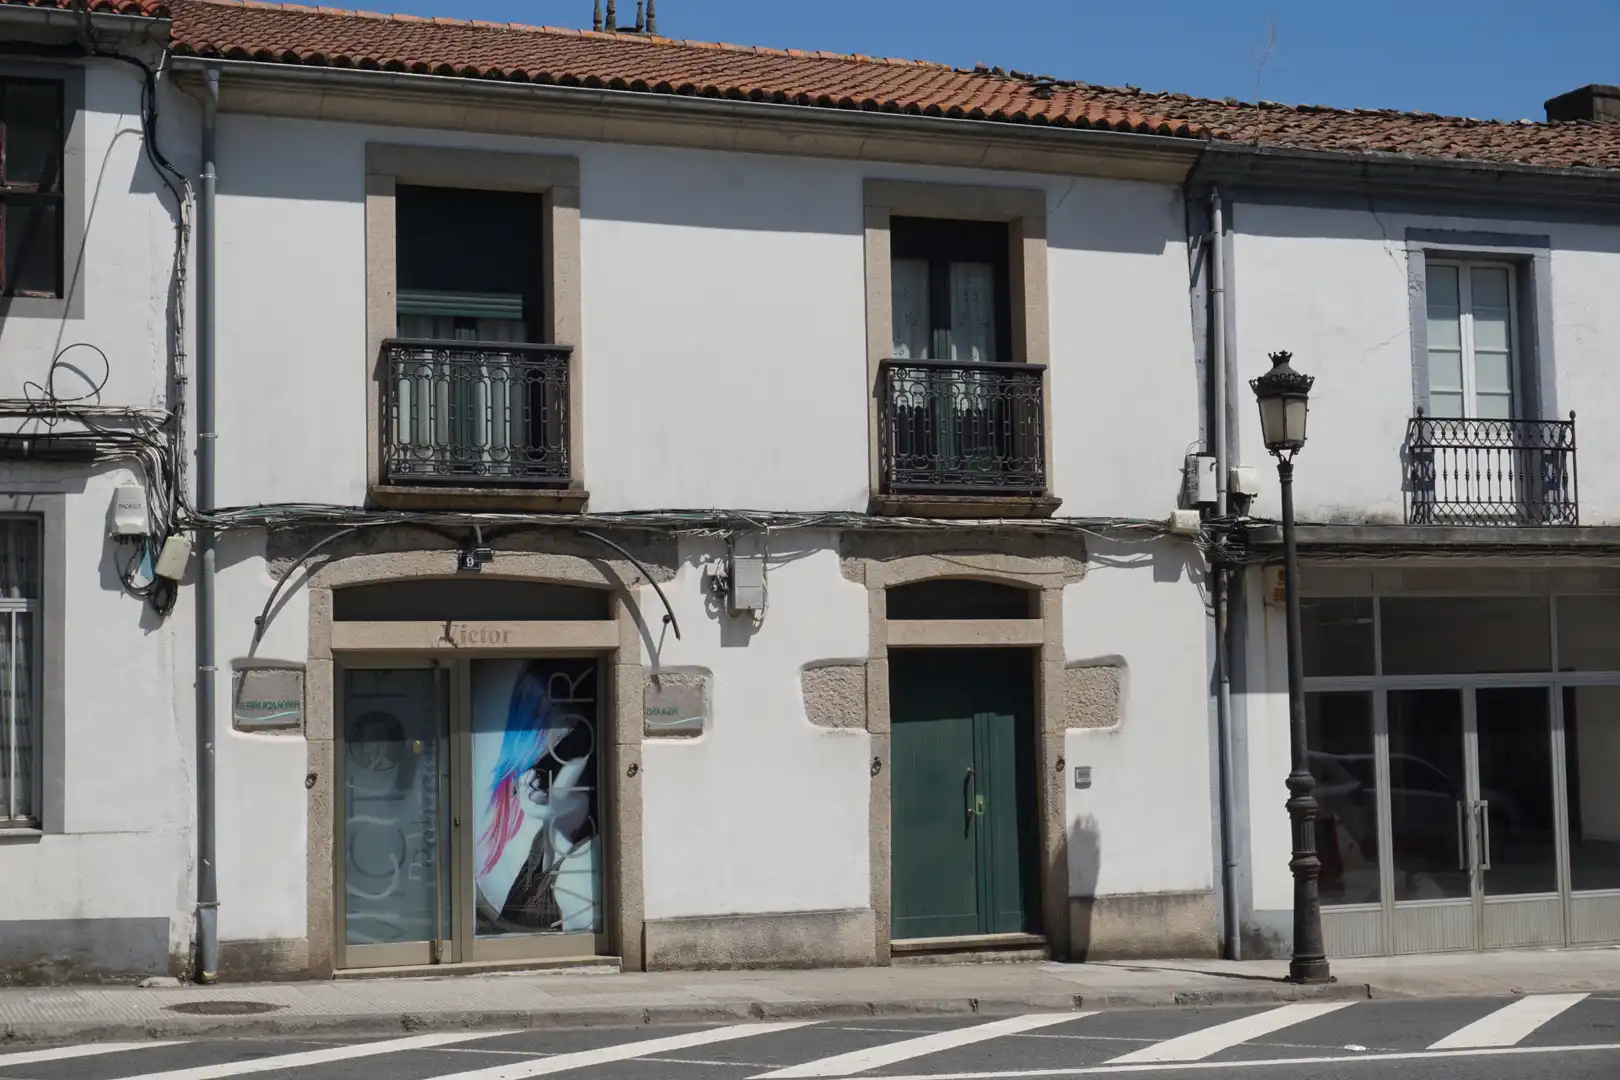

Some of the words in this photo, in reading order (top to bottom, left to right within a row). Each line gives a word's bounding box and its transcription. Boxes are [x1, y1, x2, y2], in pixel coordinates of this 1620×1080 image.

[466, 556, 475, 567] 9
[440, 623, 512, 644] Victor
[548, 664, 596, 929] VICTOR
